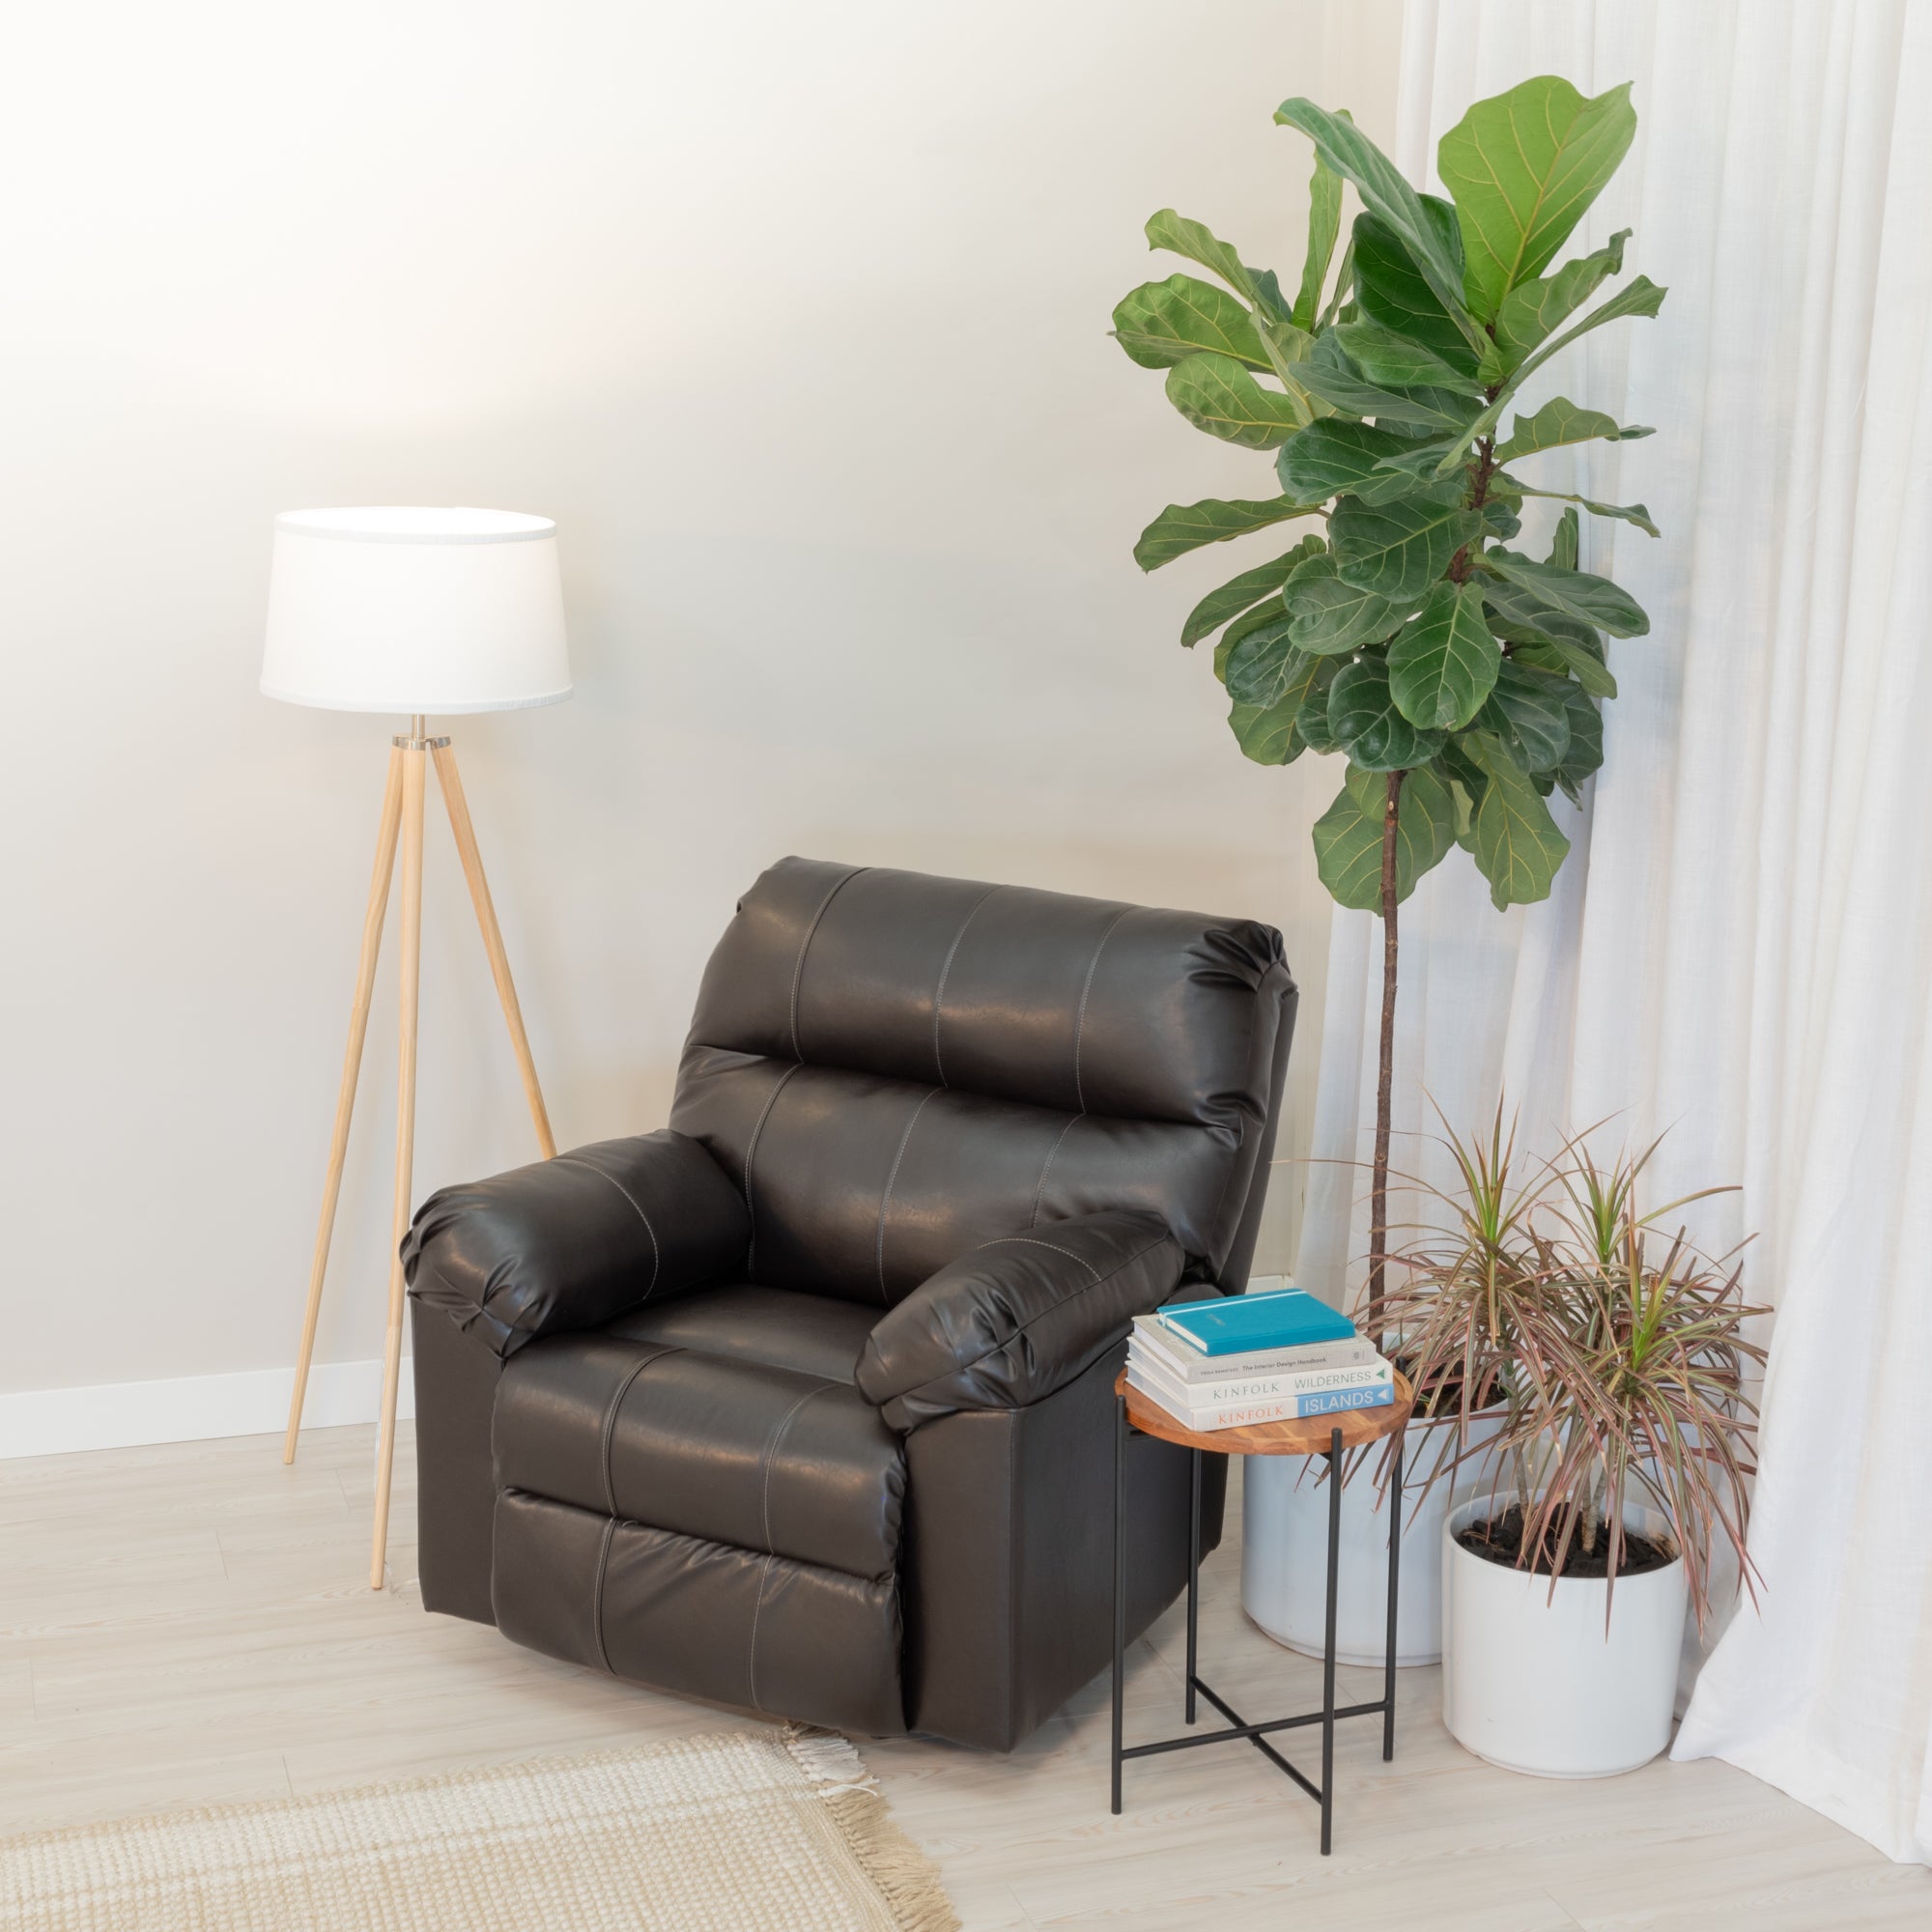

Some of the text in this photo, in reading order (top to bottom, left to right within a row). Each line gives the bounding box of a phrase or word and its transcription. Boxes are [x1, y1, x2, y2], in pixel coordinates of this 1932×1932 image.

[1276, 1360, 1296, 1369] Design
[1297, 1357, 1326, 1366] Handbook
[1213, 1371, 1372, 1400] KINFOLK WILDERNESS
[1218, 1390, 1374, 1425] KINFOLK ISLANDS
